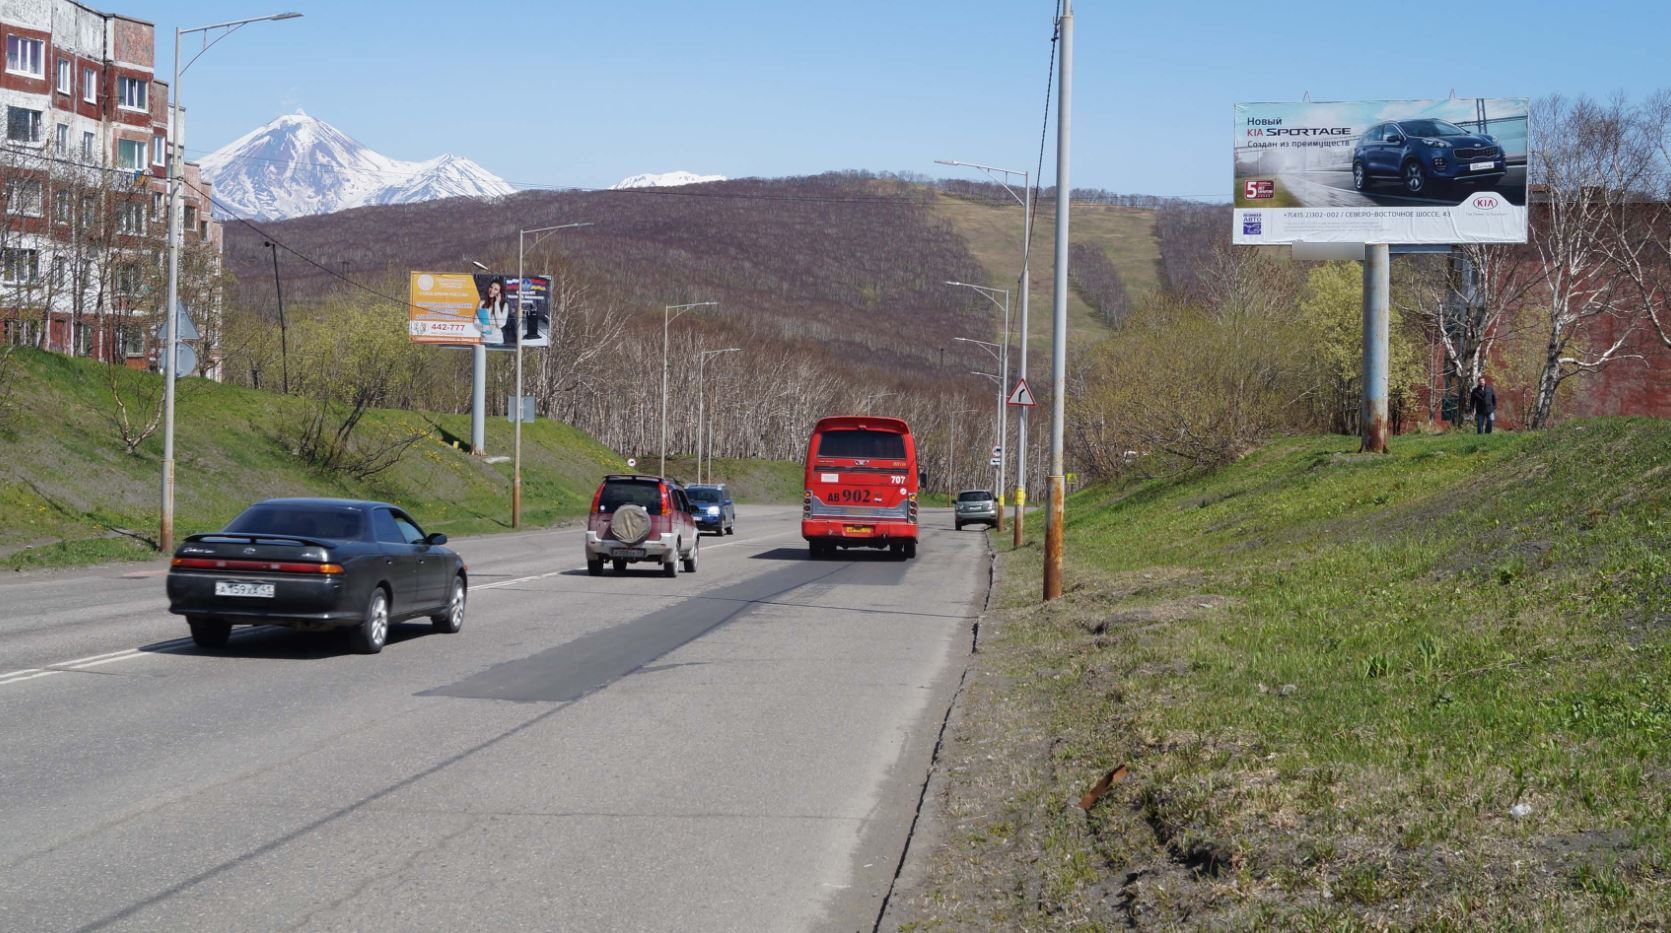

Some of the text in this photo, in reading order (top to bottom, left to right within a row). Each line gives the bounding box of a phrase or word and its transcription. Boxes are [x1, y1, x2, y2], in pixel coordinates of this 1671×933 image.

[1247, 117, 1282, 126] Новый
[1247, 128, 1352, 137] KIA SPORTAGE
[1247, 141, 1278, 149] Создан
[1246, 181, 1257, 198] 5
[431, 323, 465, 331] 442-777
[891, 475, 906, 484] 707
[842, 489, 871, 503] 902
